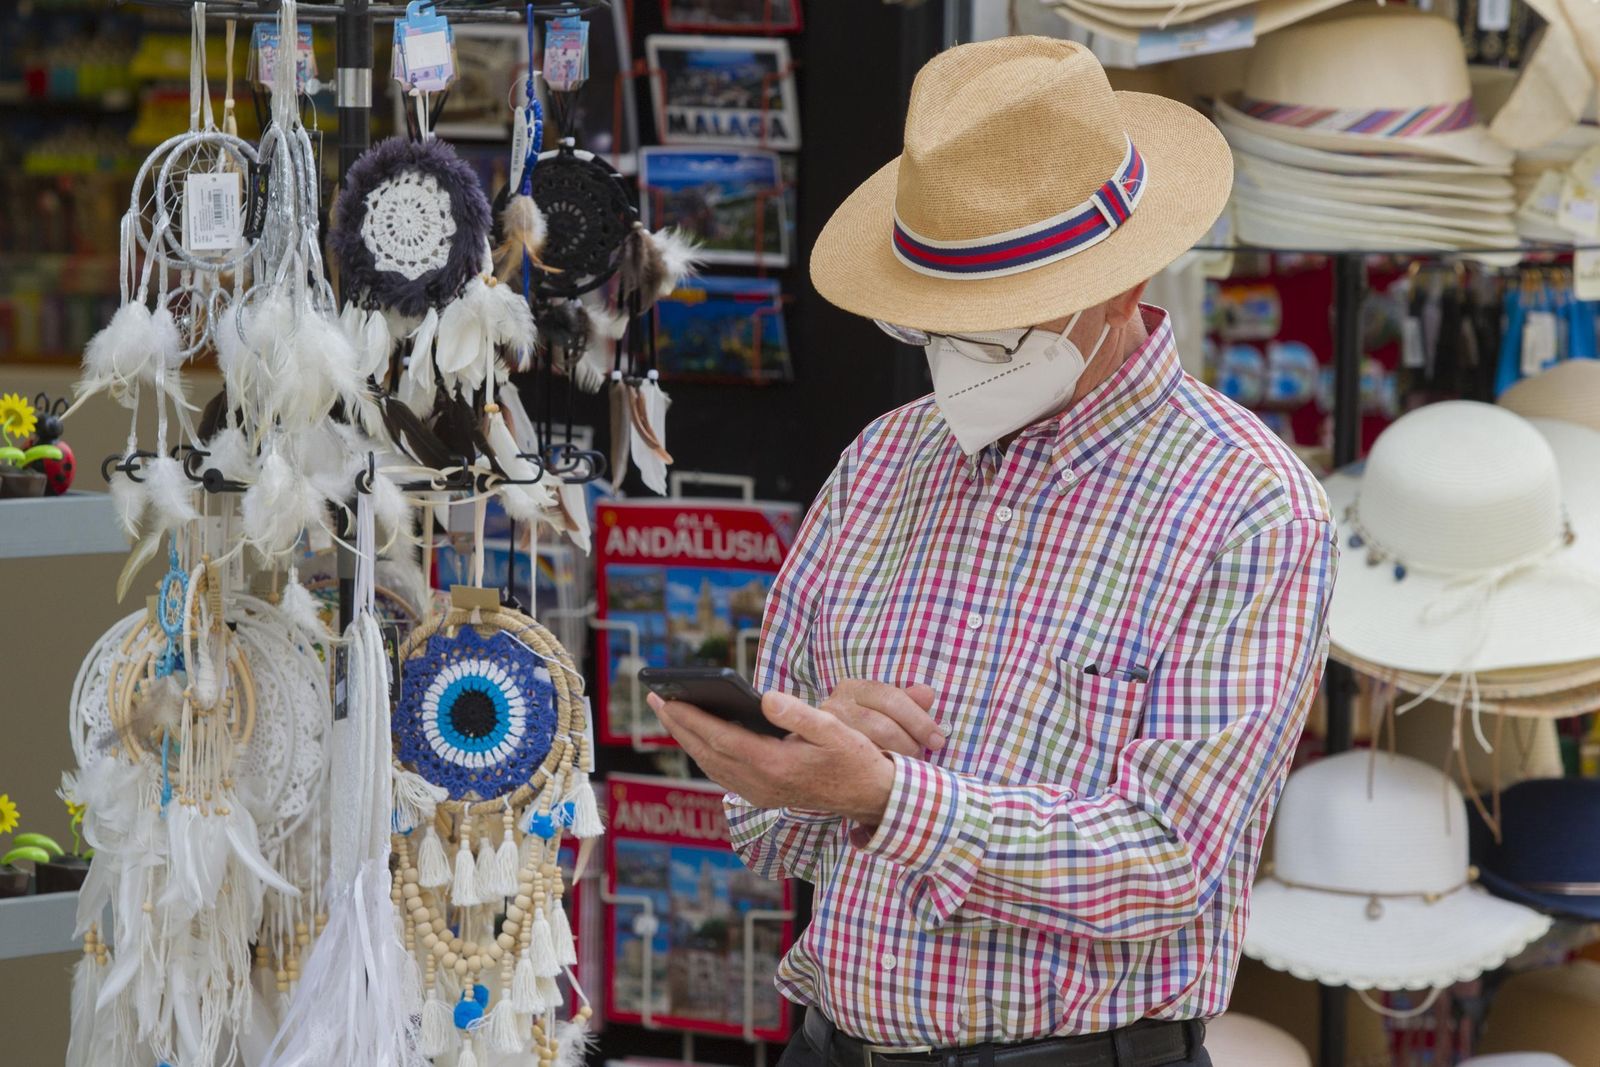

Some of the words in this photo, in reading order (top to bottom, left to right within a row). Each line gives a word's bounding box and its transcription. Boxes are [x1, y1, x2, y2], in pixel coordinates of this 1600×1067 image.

[668, 112, 789, 140] MALAGA
[674, 512, 720, 530] ALL
[605, 525, 782, 565] ANDALUSIA
